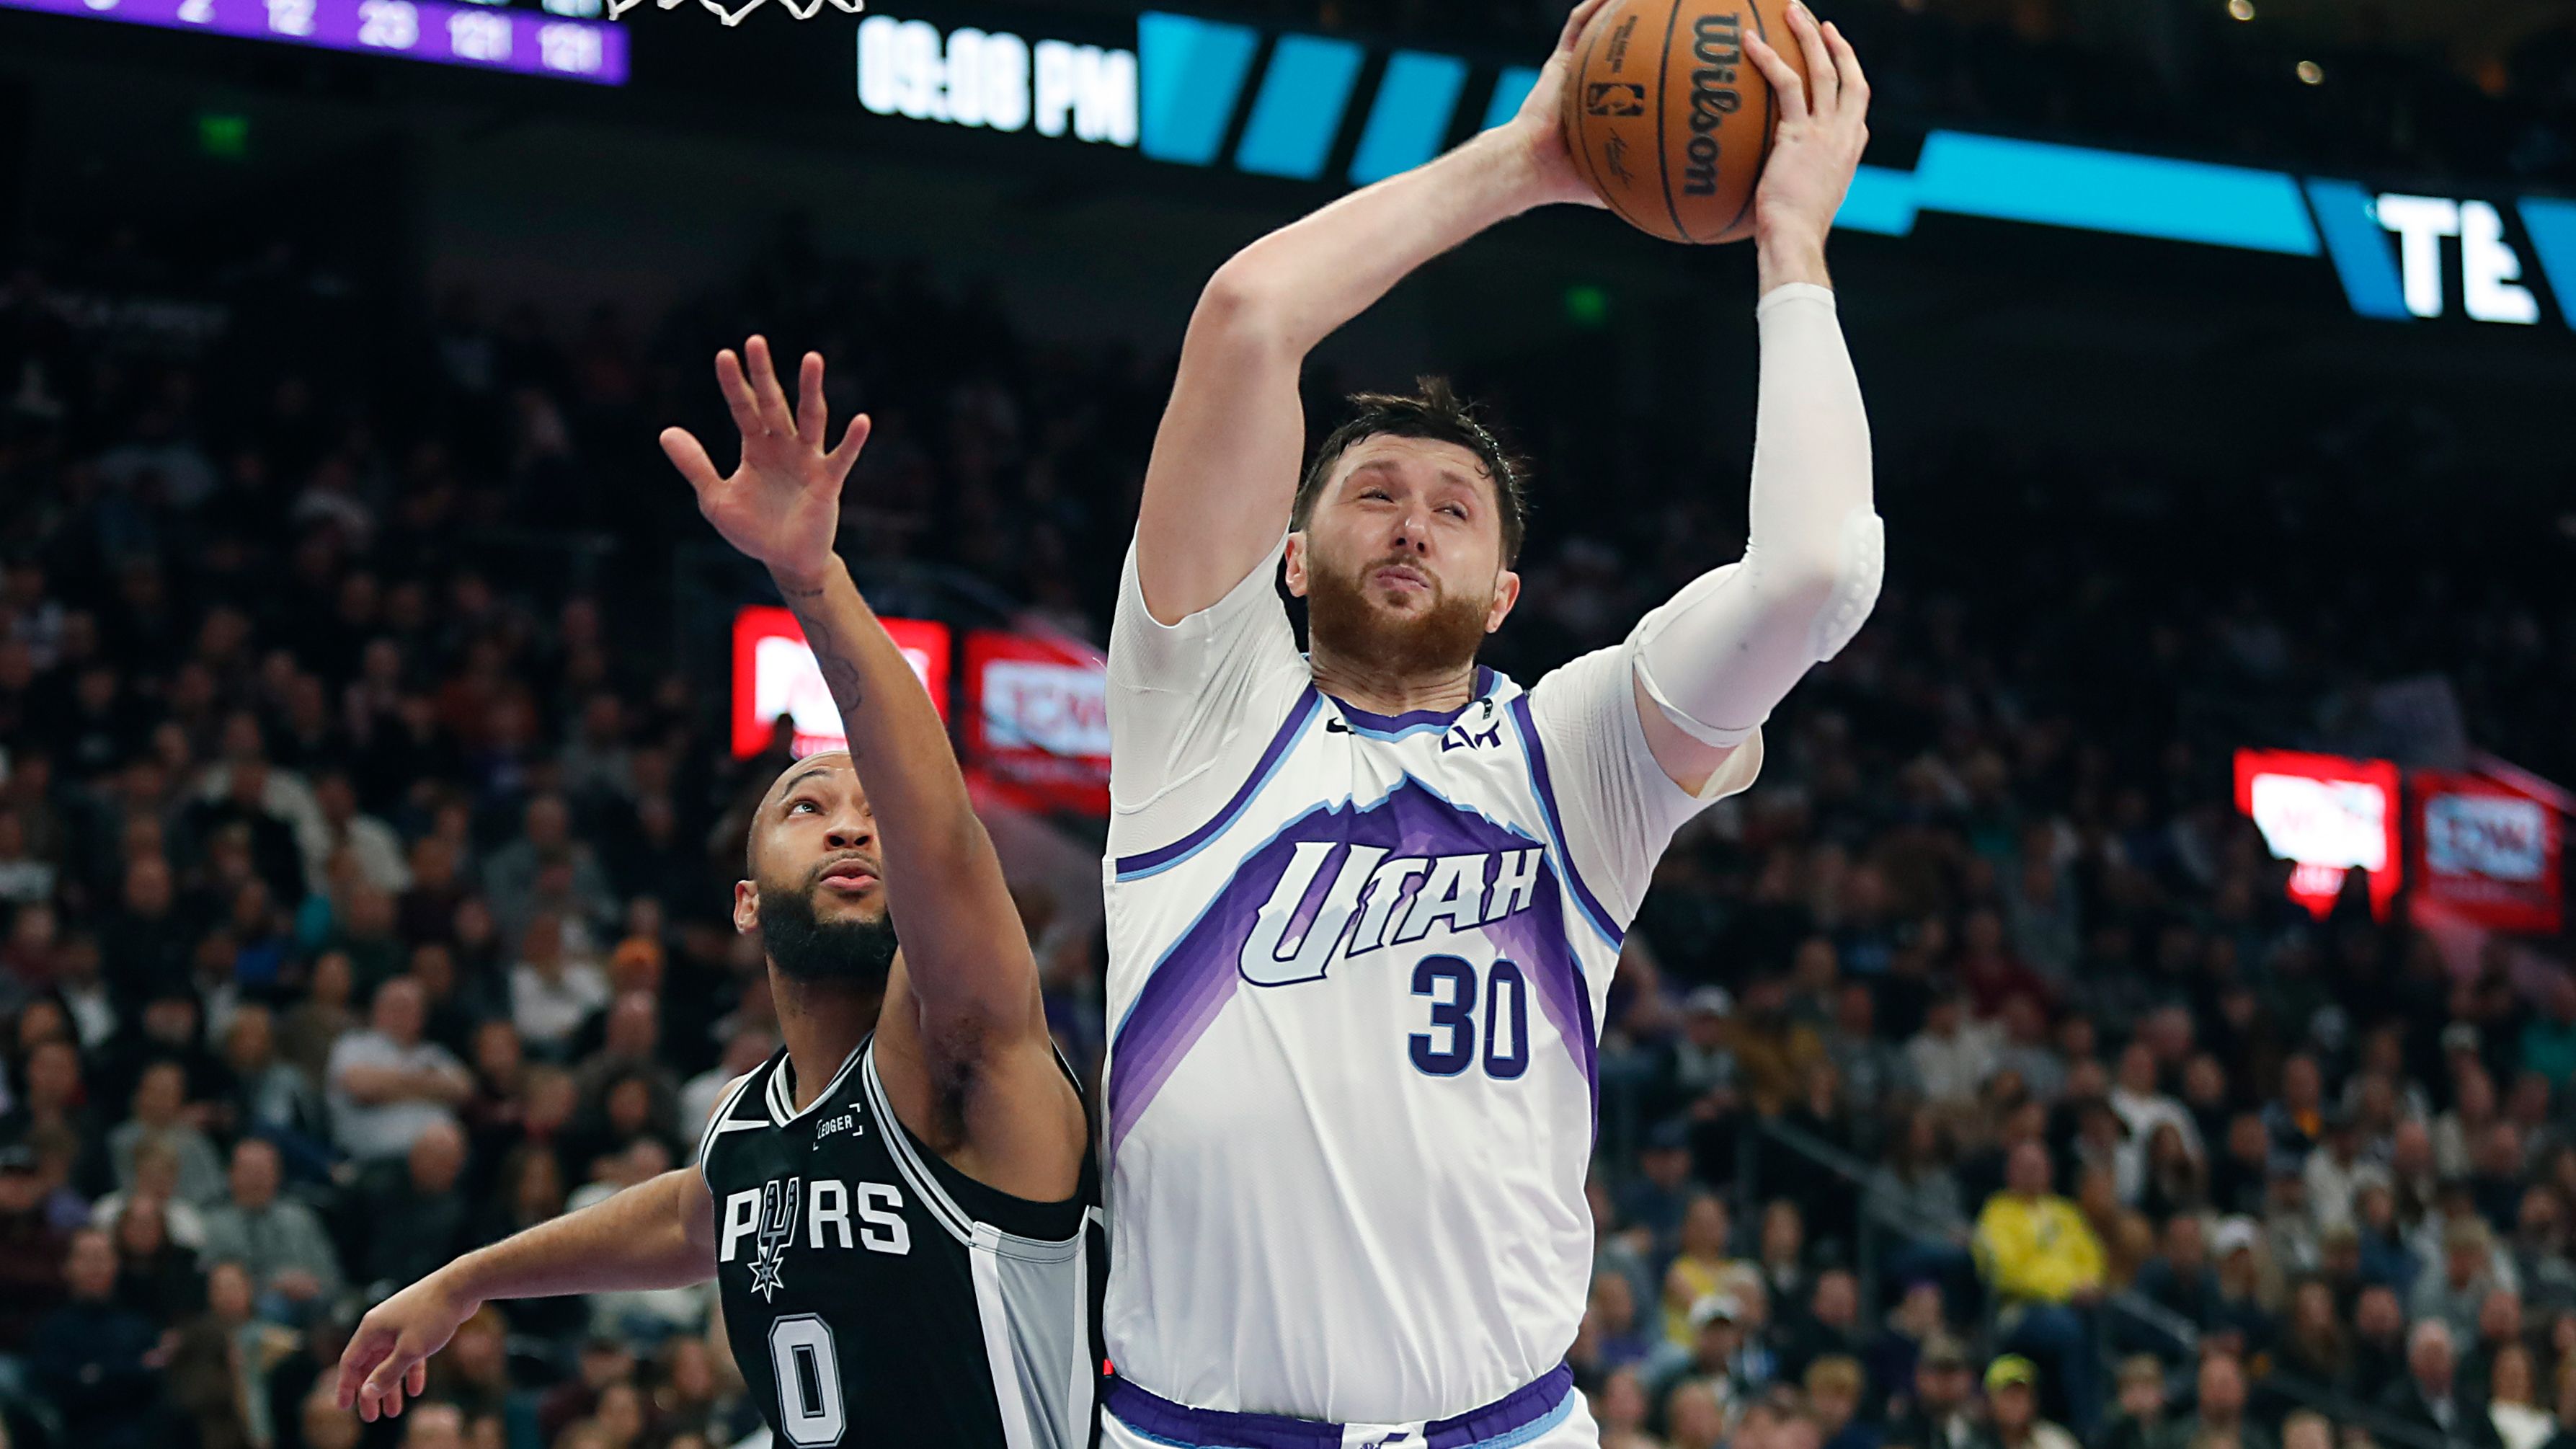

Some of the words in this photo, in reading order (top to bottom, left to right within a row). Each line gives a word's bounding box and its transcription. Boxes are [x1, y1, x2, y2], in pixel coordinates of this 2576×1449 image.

[1034, 39, 1139, 147] PM
[1684, 12, 1742, 197] Wilson
[1238, 841, 1546, 988] UTAH
[1408, 953, 1530, 1081] 30
[817, 1113, 853, 1140] LEDGER
[720, 1177, 911, 1303] PURS
[767, 1312, 847, 1449] 0
